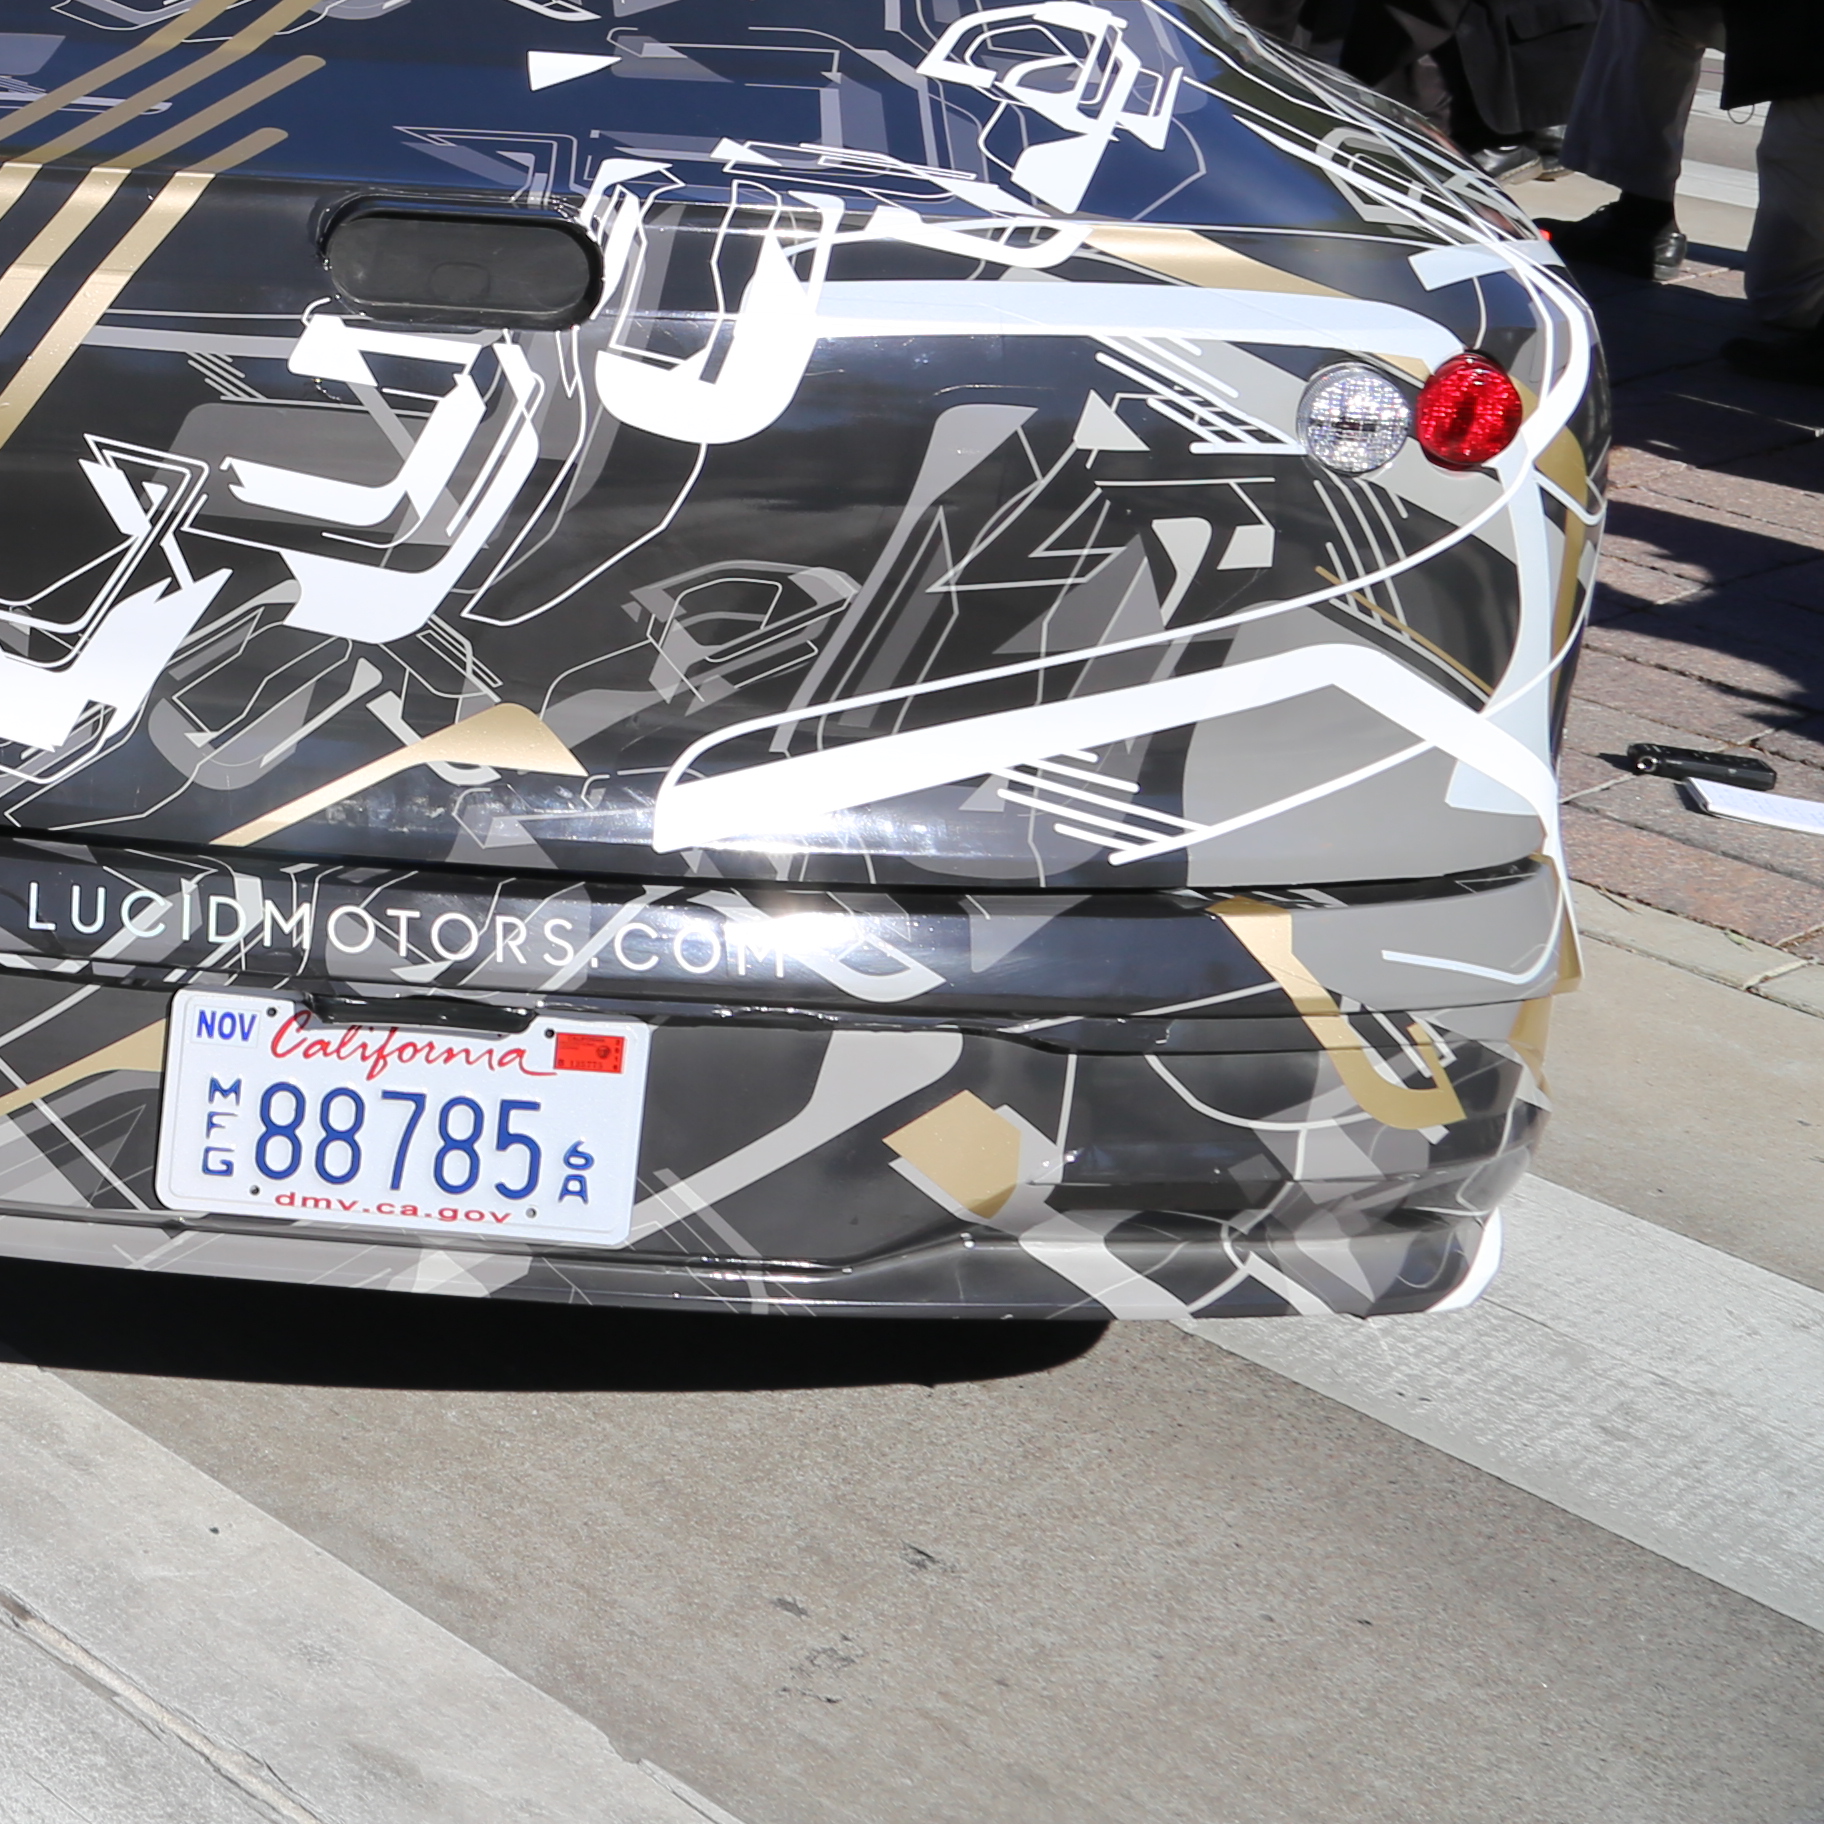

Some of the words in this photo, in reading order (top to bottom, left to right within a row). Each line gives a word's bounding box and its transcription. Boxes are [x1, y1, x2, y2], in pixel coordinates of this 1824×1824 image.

[27, 881, 788, 980] LUCIDMOTORS.COM
[196, 1009, 258, 1043] NOV
[270, 1009, 558, 1081] California
[254, 1080, 543, 1201] 88785
[273, 1190, 514, 1226] dmv.ca.gov
